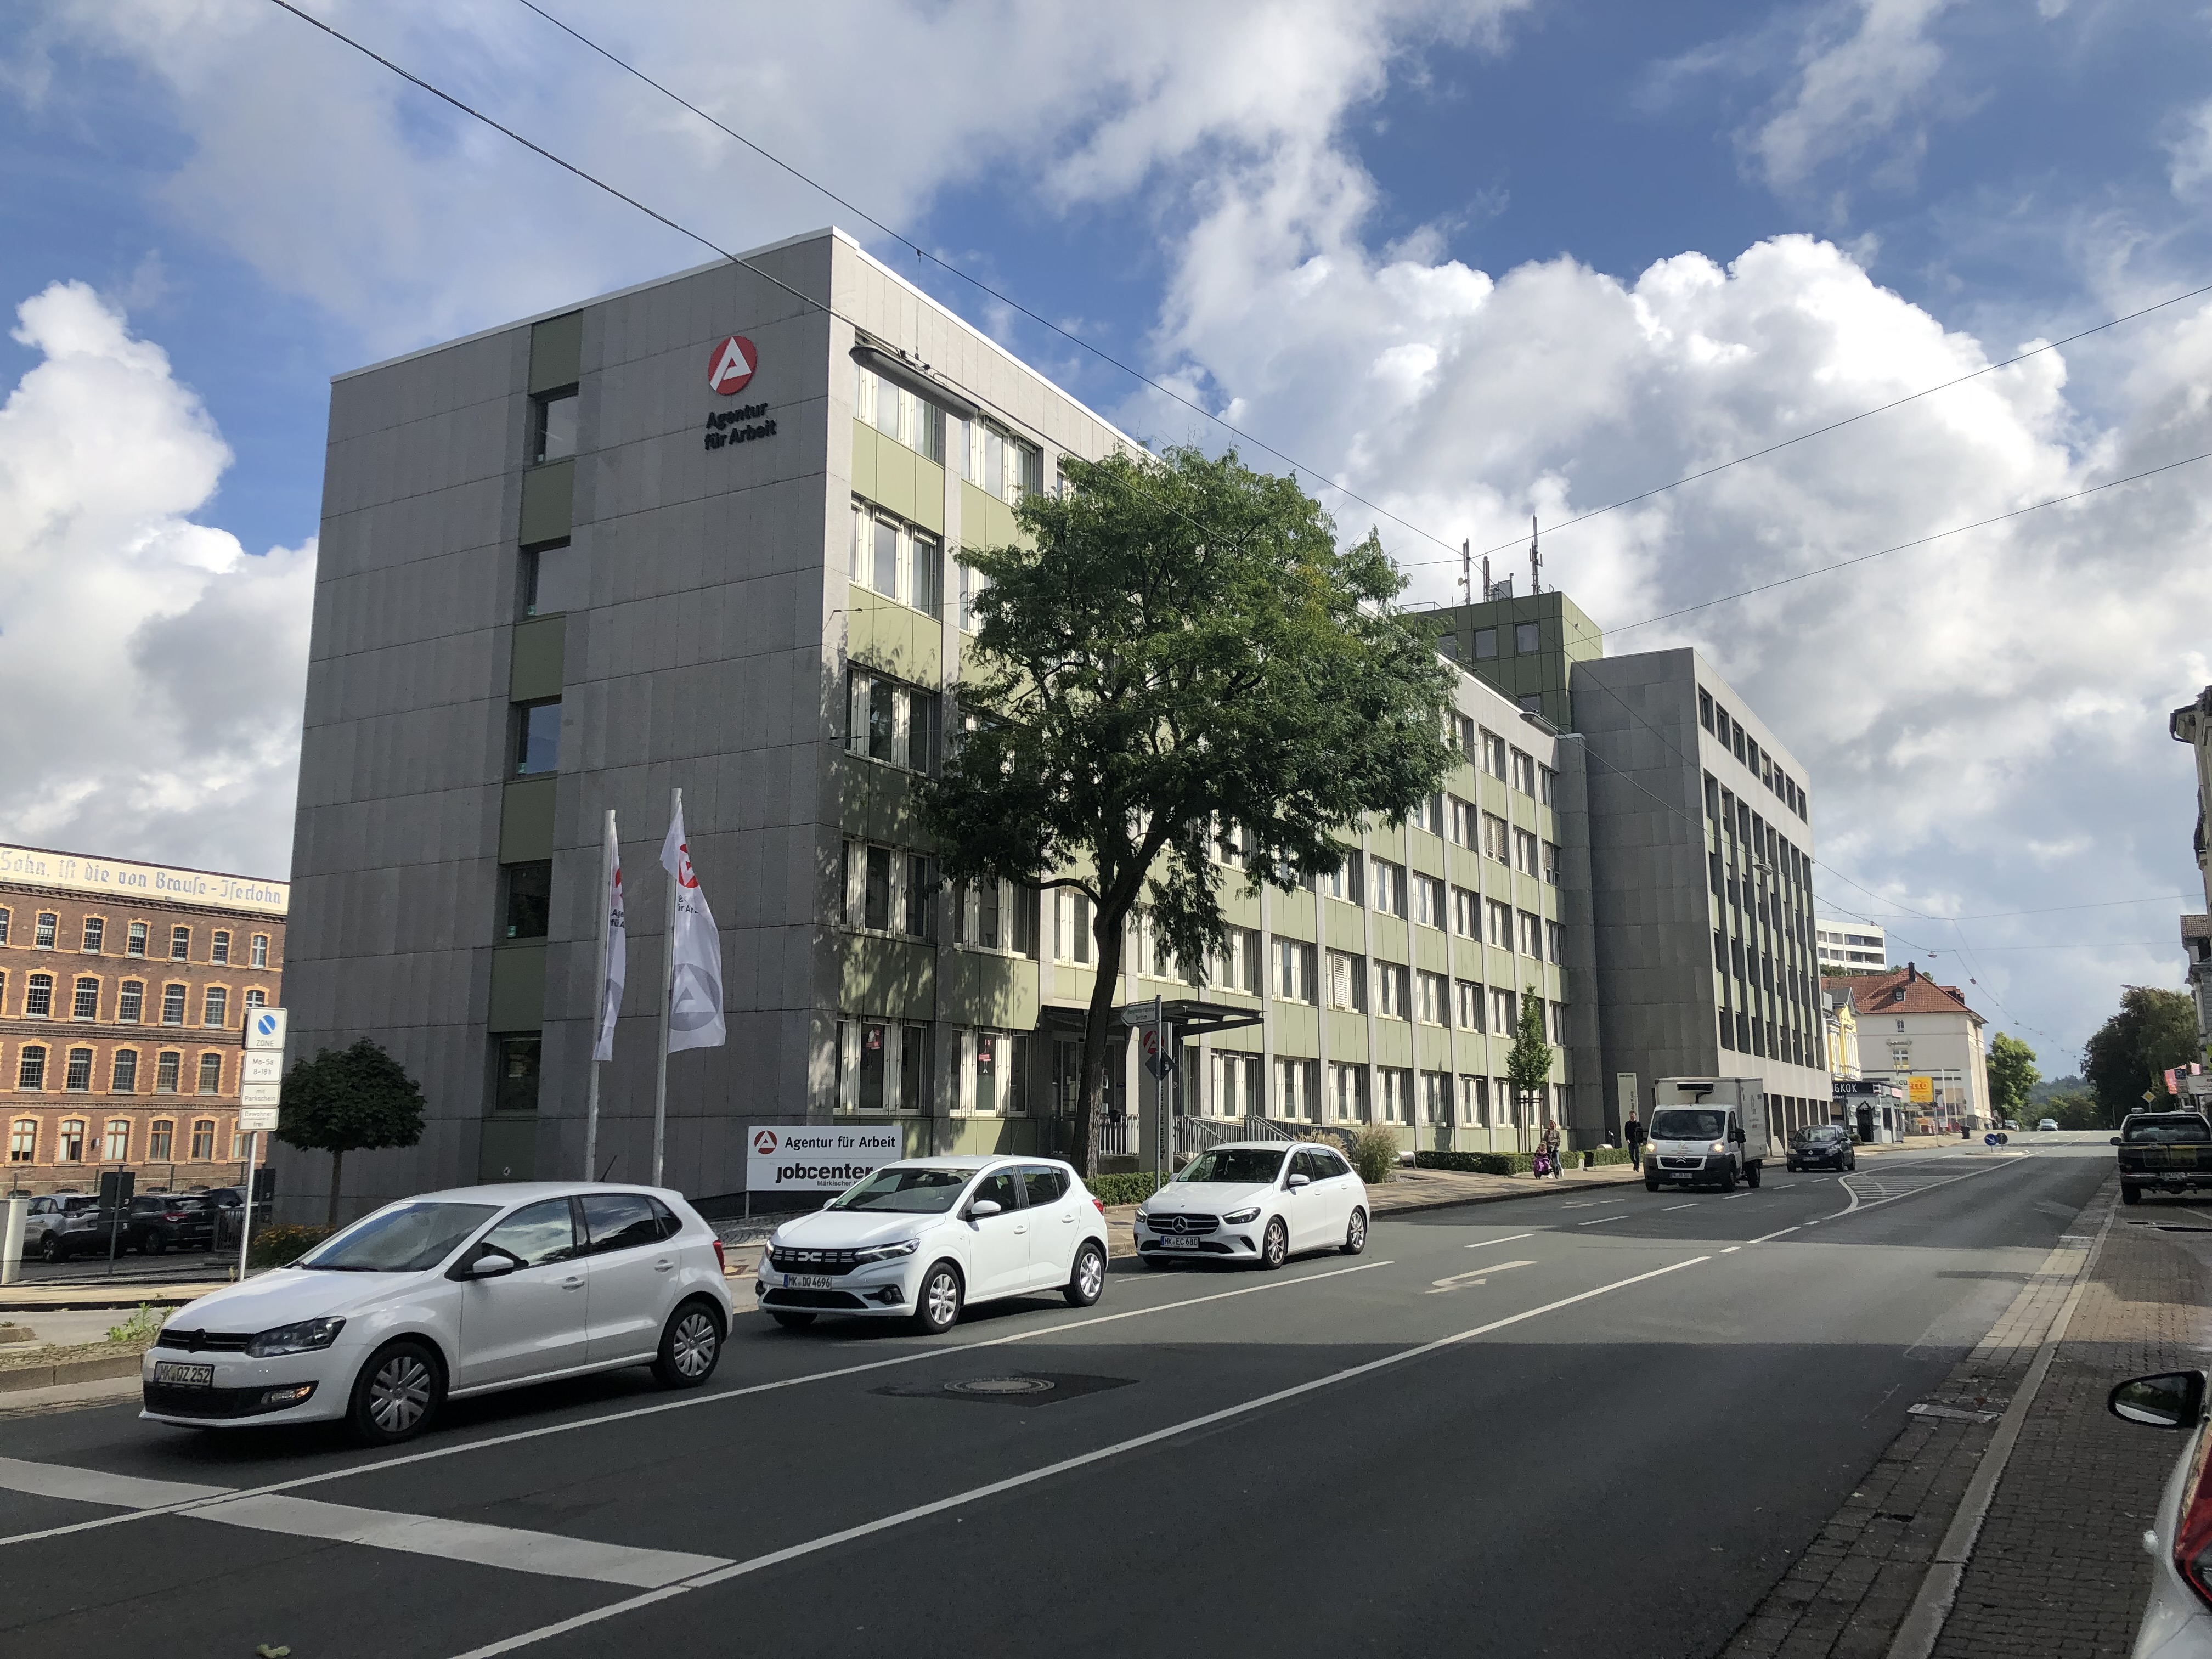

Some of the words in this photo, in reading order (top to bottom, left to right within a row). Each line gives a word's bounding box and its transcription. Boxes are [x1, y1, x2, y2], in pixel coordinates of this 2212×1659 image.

[706, 403, 768, 430] Agentur
[704, 432, 727, 450] für
[729, 420, 777, 445] Arbeit
[84, 862, 109, 882] die
[118, 871, 146, 888] von
[785, 1137, 833, 1150] Agentur
[838, 1136, 855, 1148] für
[859, 1136, 896, 1148] Arbeit
[775, 1163, 873, 1183] jobcenter
